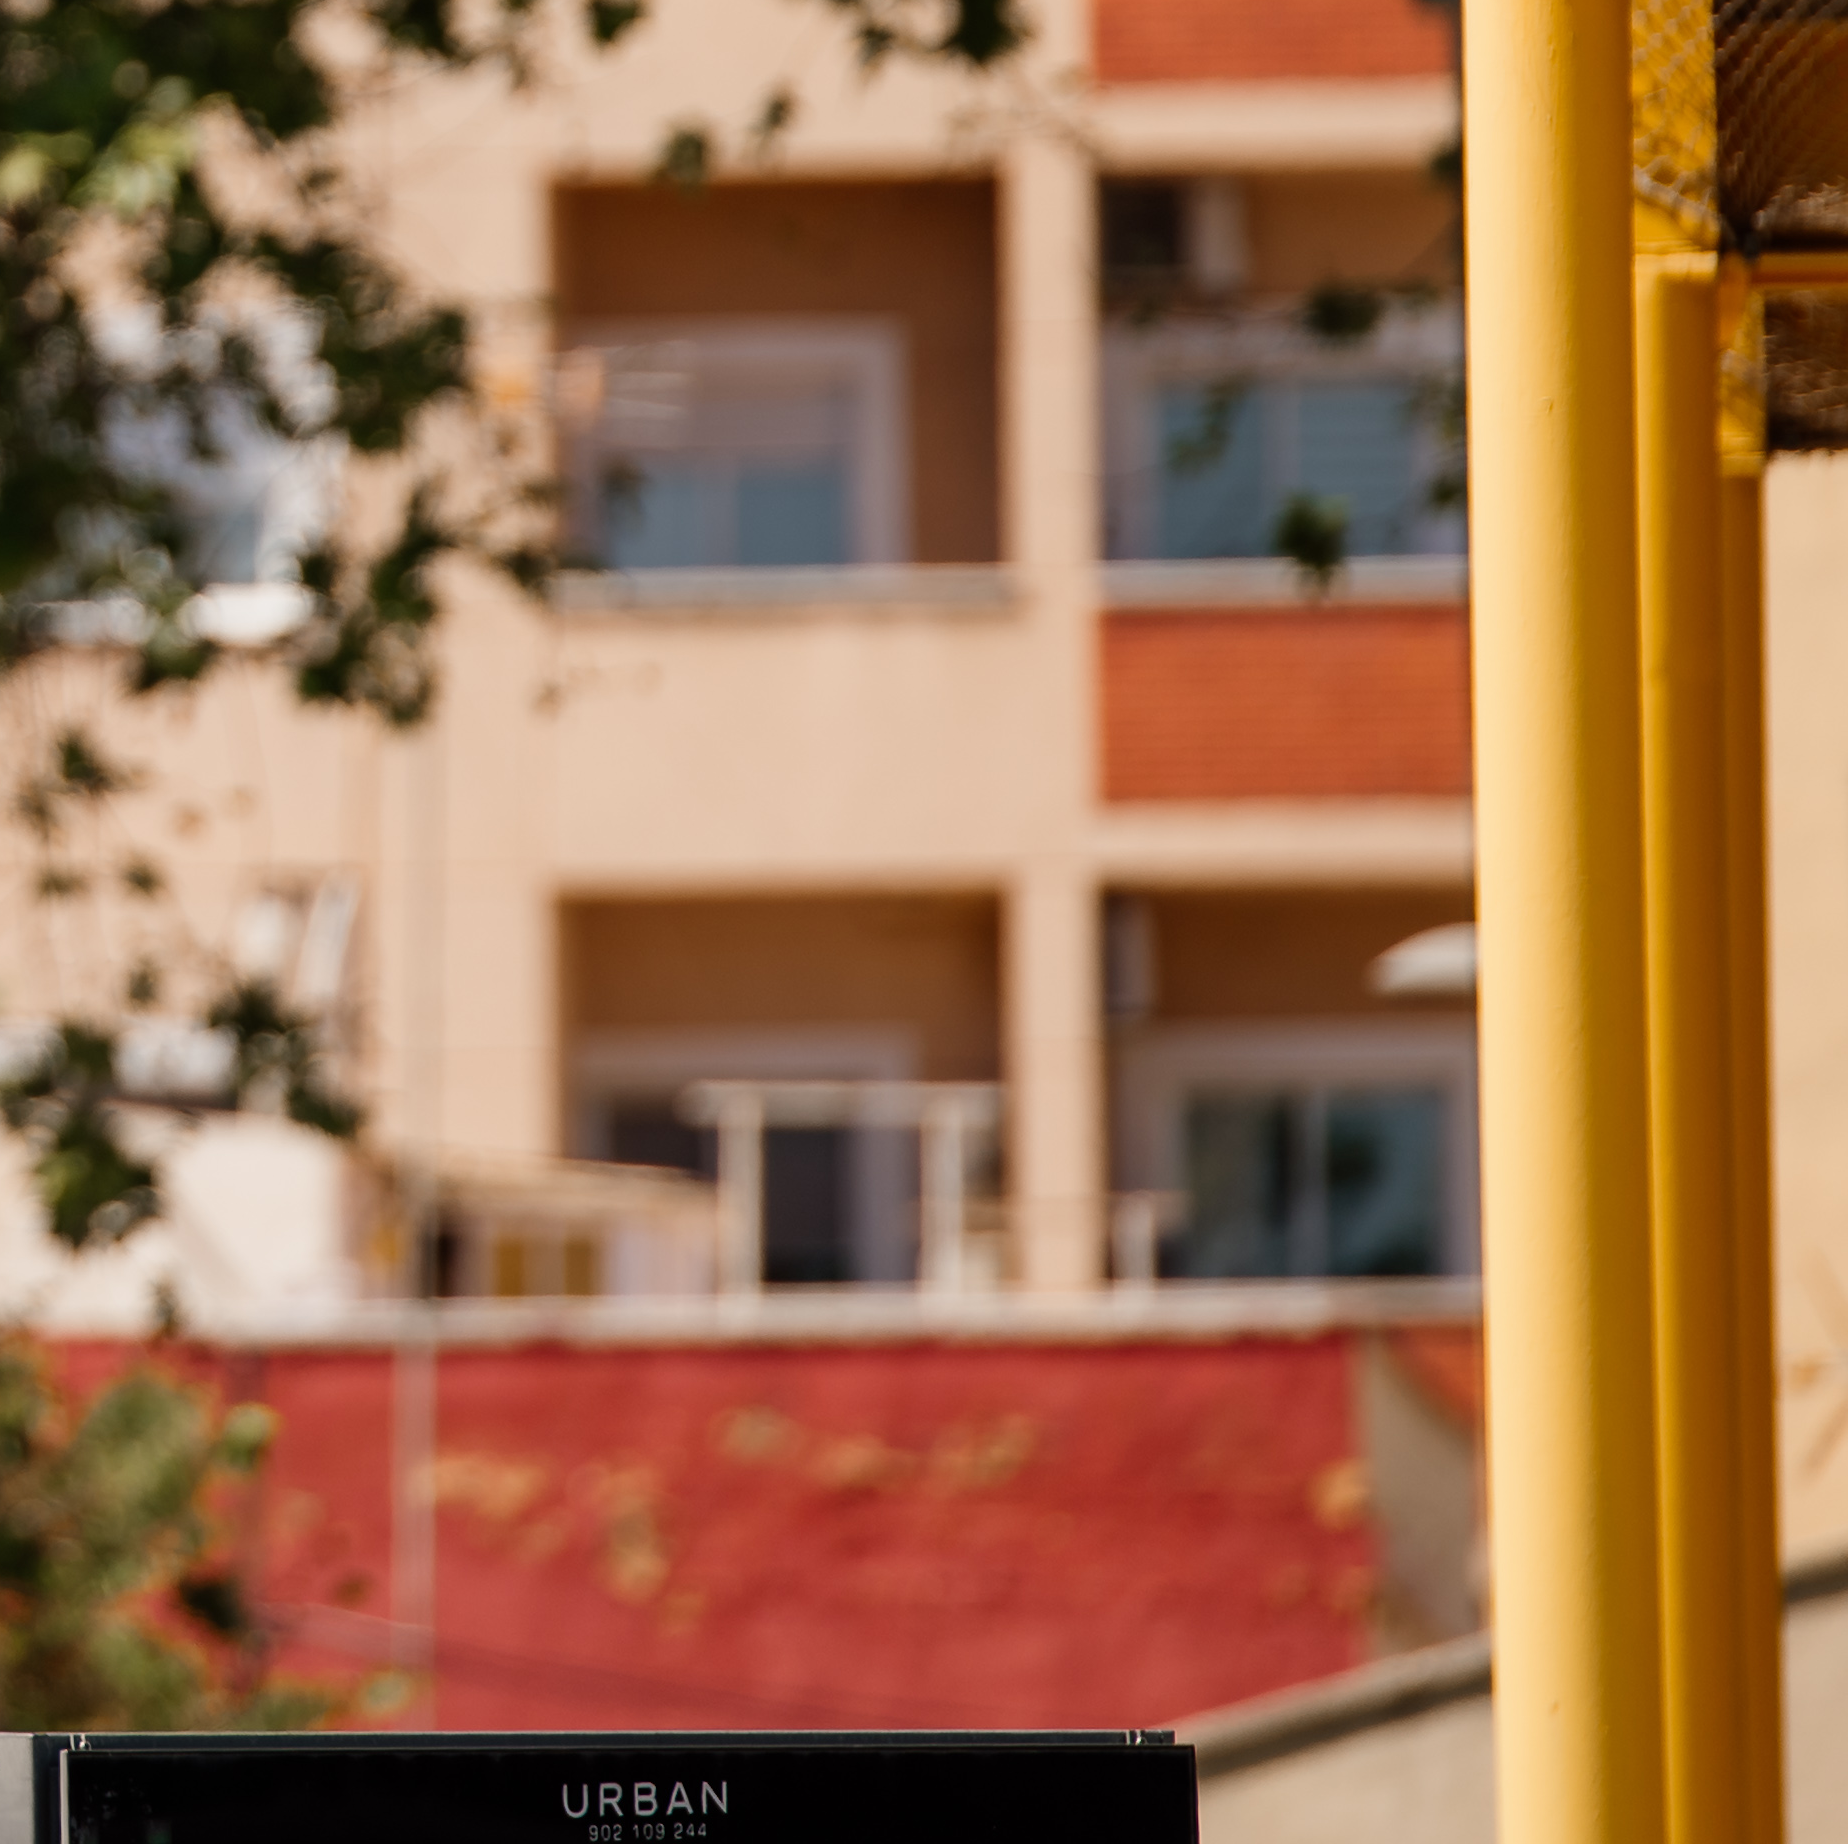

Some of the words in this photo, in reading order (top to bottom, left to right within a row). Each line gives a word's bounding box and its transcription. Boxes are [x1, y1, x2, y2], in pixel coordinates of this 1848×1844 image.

[562, 1781, 728, 1819] URBAN
[589, 1824, 623, 1842] 902
[632, 1823, 665, 1841] 109
[673, 1822, 707, 1840] 244
